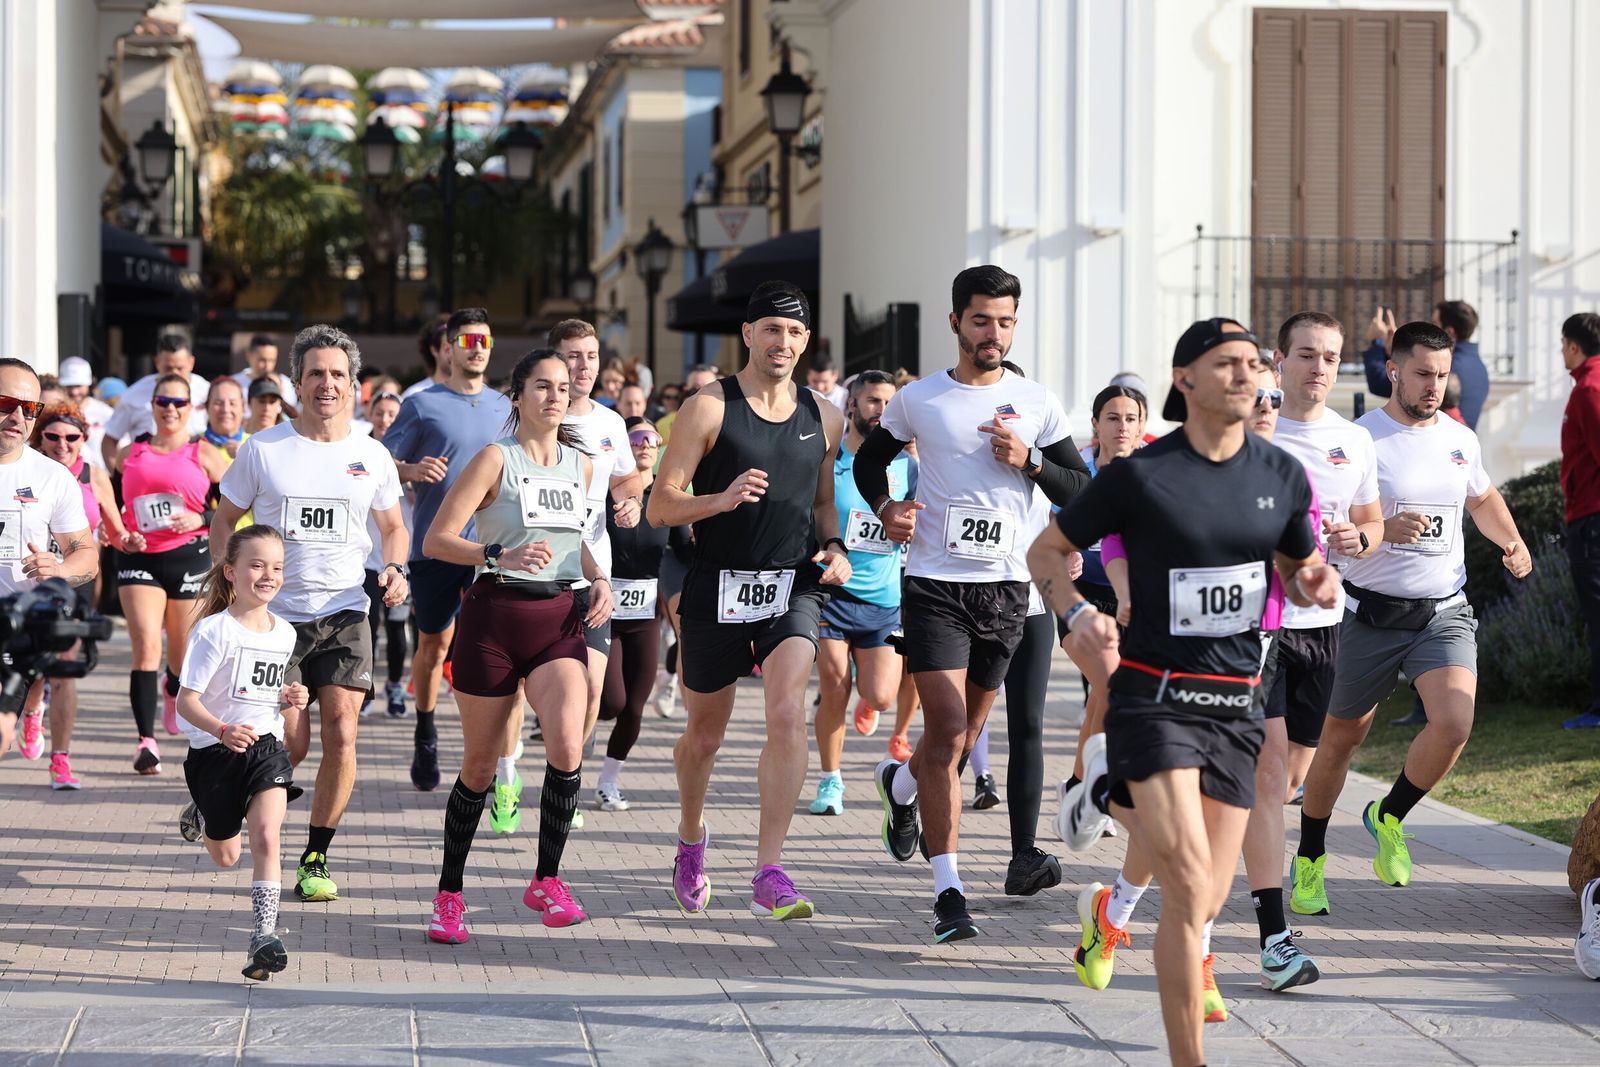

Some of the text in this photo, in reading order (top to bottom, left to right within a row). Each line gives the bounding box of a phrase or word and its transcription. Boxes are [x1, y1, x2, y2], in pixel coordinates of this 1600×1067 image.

[149, 501, 172, 519] 119
[538, 488, 574, 511] 408
[300, 507, 334, 529] 501
[960, 517, 1002, 545] 284
[620, 589, 646, 607] 291
[737, 583, 777, 606] 488
[1197, 584, 1243, 615] 108
[1168, 687, 1250, 708] WONG
